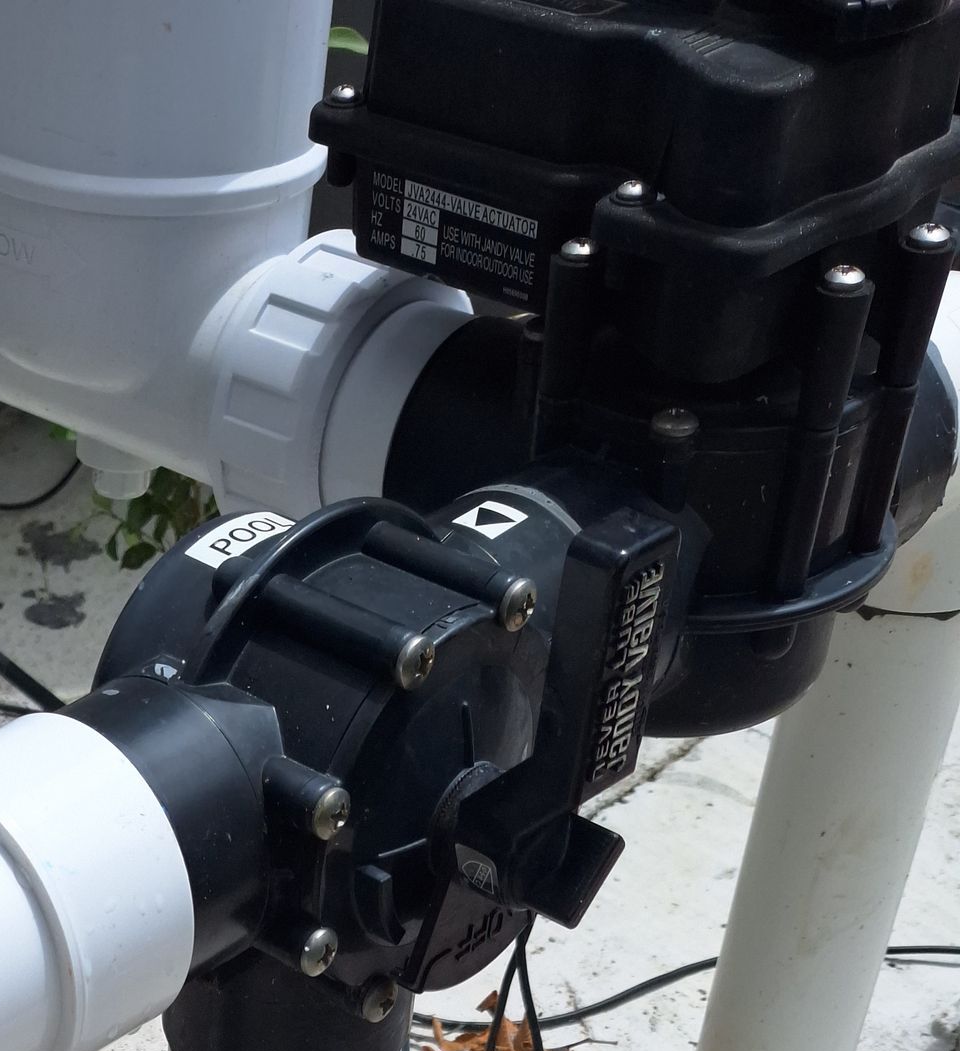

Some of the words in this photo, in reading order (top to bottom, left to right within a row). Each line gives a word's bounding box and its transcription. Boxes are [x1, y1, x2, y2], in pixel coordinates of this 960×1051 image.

[372, 191, 401, 214] VOLTS
[406, 203, 437, 226] 24VAC
[373, 171, 403, 195] MODEL
[482, 208, 537, 238] ACTUATOR
[370, 229, 396, 250] AMPS
[412, 244, 426, 260] .75
[371, 210, 383, 227] HZ
[414, 225, 426, 241] 60
[440, 242, 455, 259] FOR
[518, 269, 535, 286] USE
[443, 224, 459, 244] USE
[461, 230, 481, 251] WITH
[481, 237, 509, 259] JANDY
[509, 246, 536, 269] VALVE
[208, 517, 295, 557] POOL
